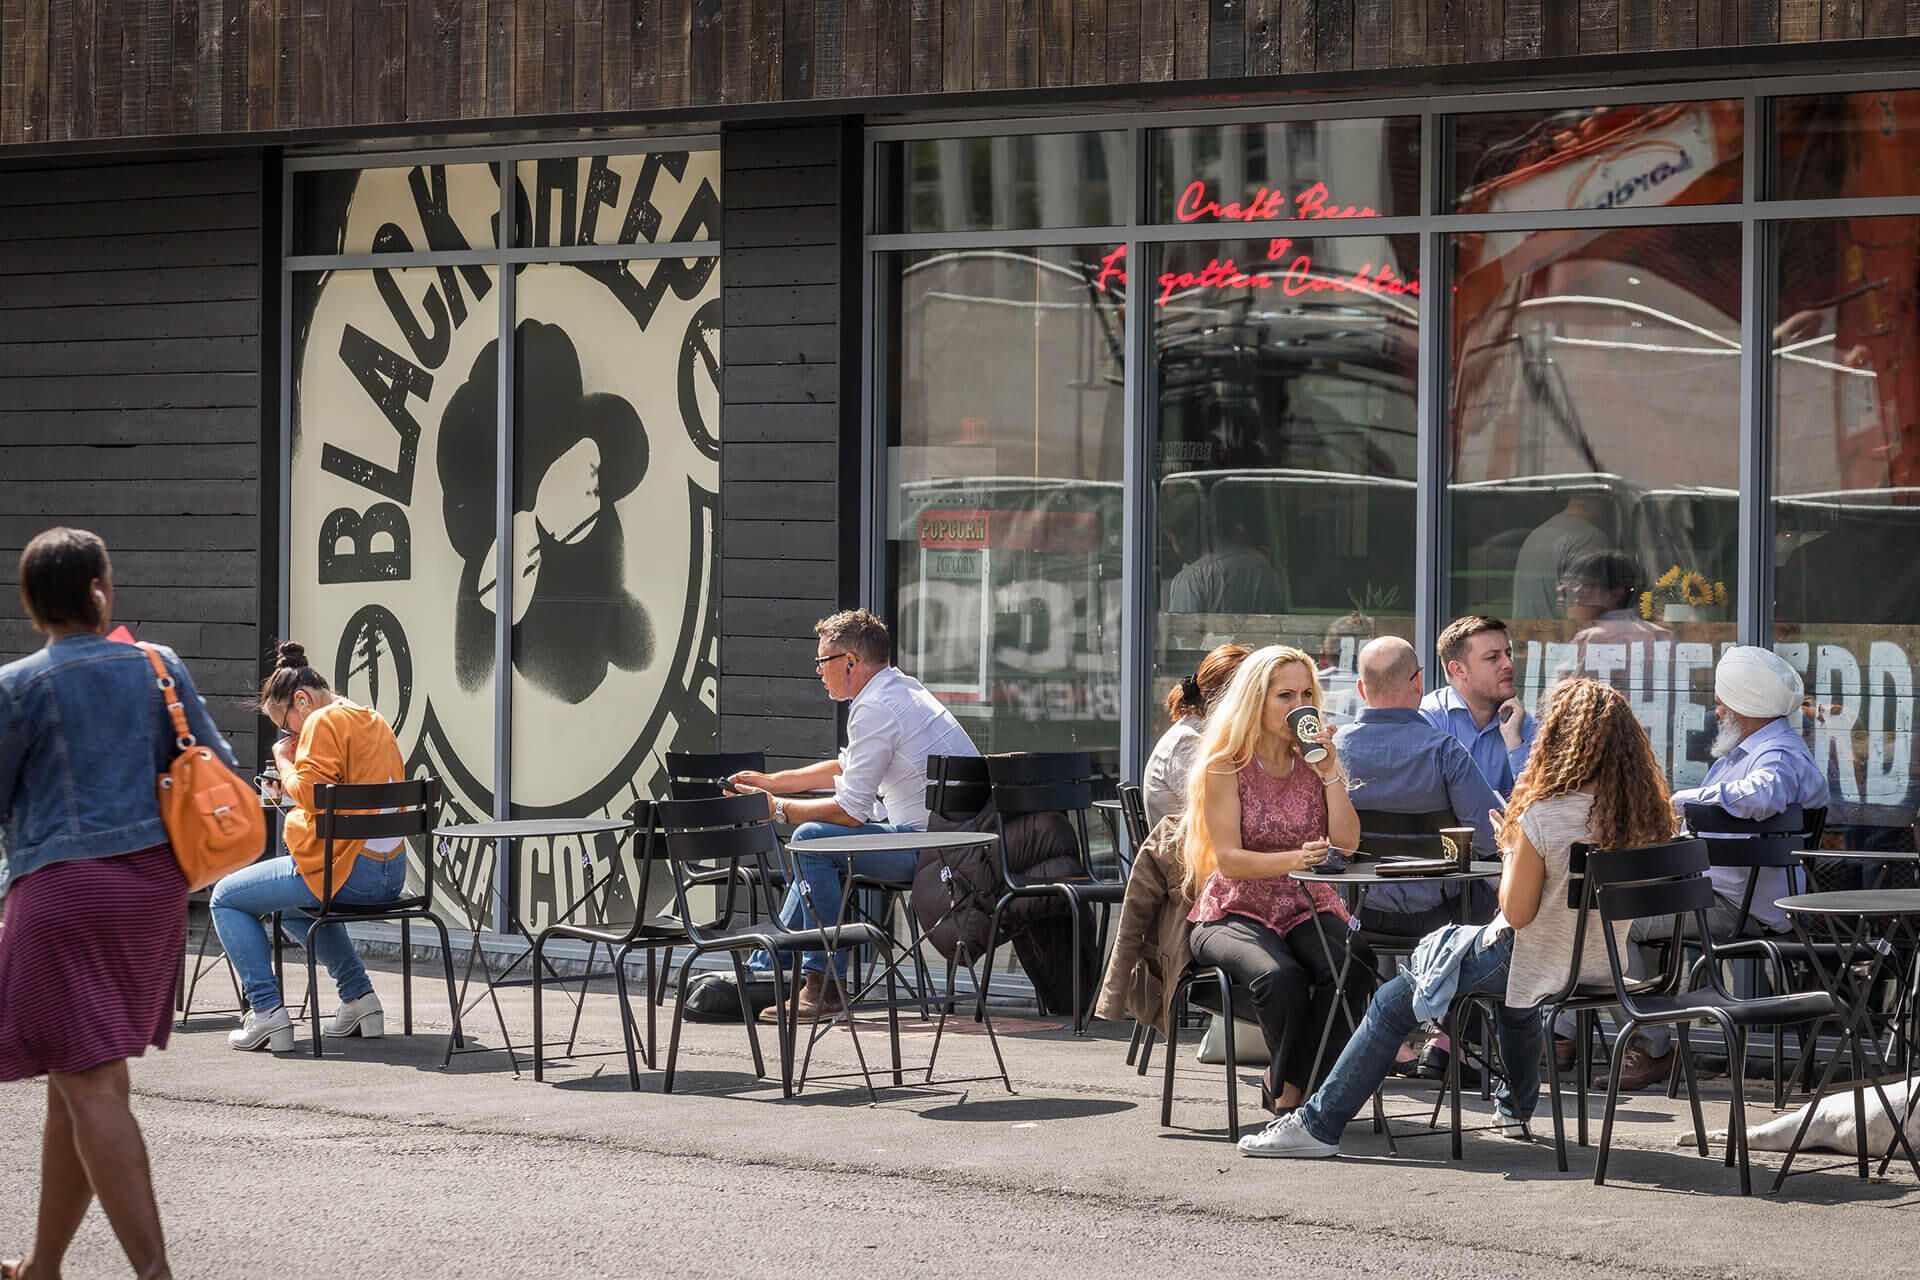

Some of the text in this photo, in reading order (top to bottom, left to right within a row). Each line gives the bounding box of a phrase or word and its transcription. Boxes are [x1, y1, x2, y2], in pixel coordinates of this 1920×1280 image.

[1176, 181, 1285, 221] Craft
[1098, 244, 1458, 307] Fogotten Cocktai
[318, 163, 493, 585] BLACK
[921, 519, 986, 541] POPCORN
[936, 555, 976, 574] POPCORN
